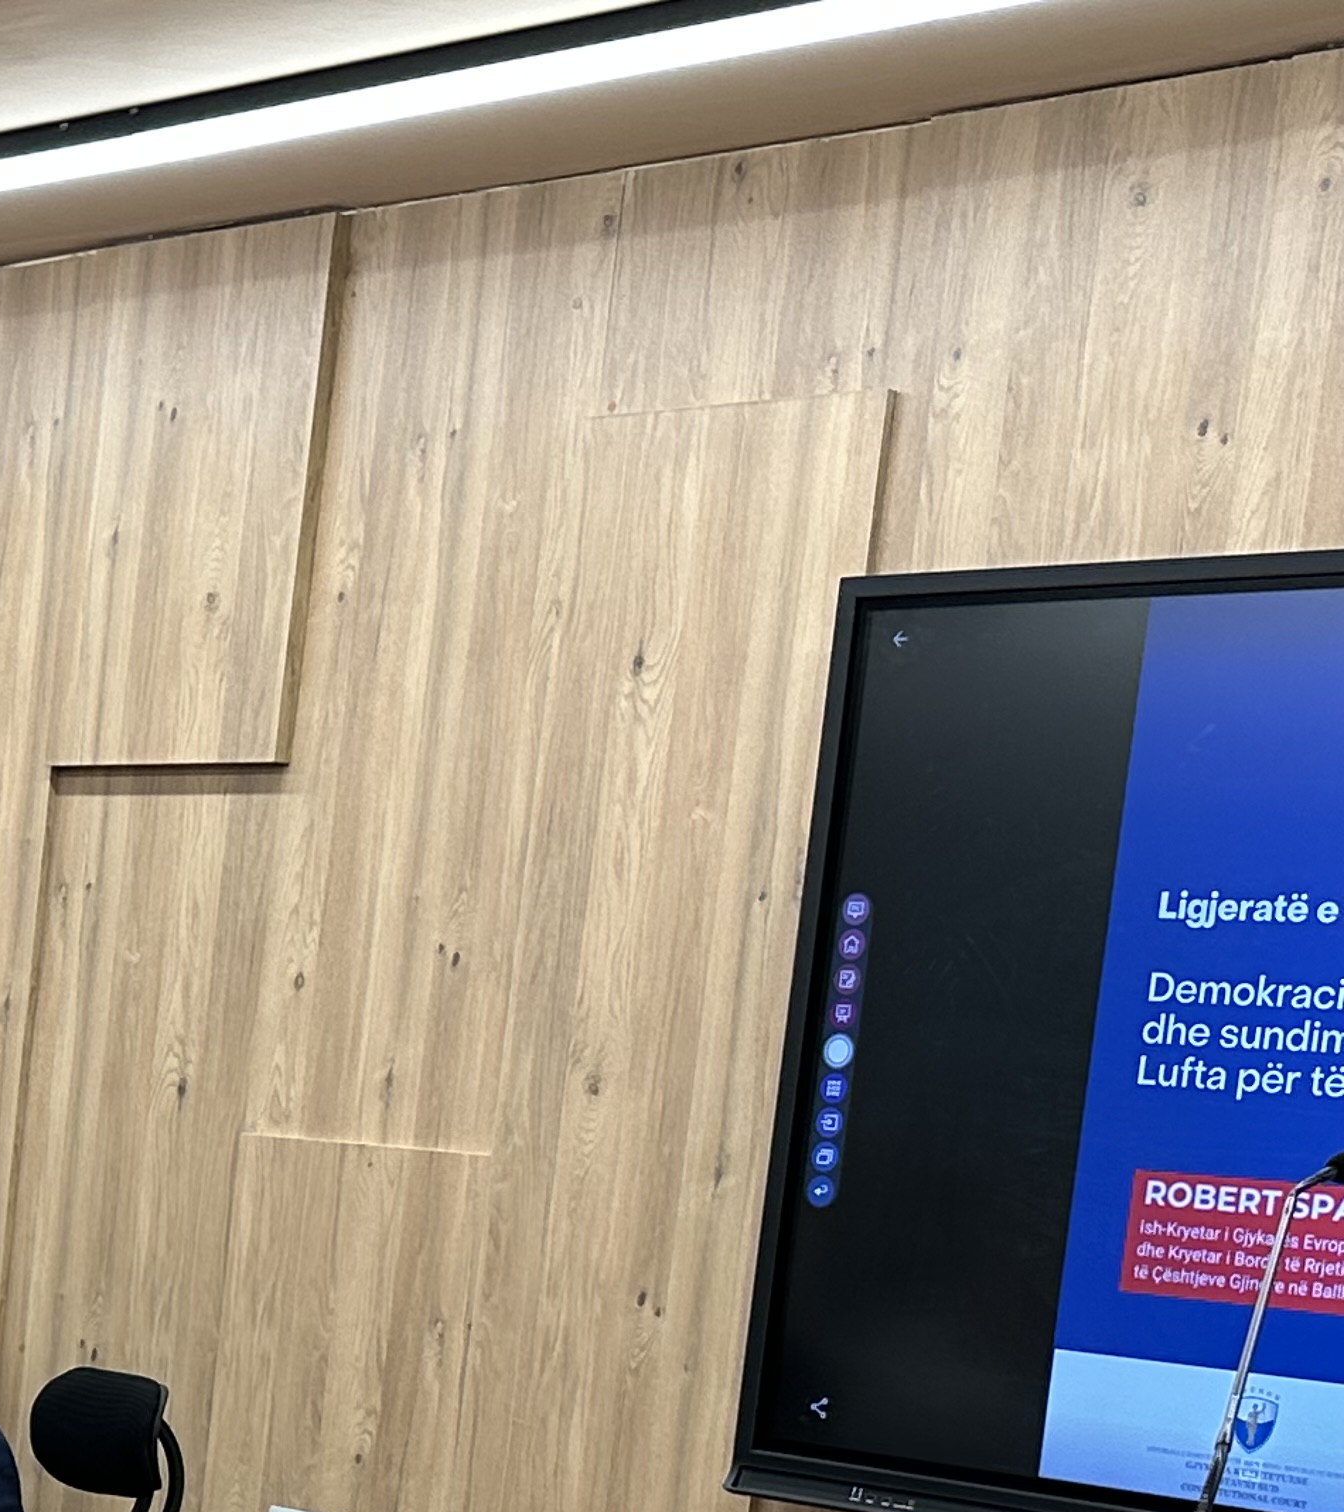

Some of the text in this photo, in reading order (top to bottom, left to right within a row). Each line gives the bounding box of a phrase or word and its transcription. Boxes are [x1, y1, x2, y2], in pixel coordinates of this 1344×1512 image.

[1158, 890, 1339, 928] Ligjeratë e
[1148, 971, 1344, 1010] Demokraci
[1142, 1013, 1344, 1054] dhe sundim
[1137, 1055, 1344, 1101] Lufta për të
[1144, 1179, 1283, 1216] ROBERT
[1223, 1226, 1229, 1241] i
[1233, 1228, 1299, 1249] Gjykas
[1136, 1241, 1165, 1258] dhe
[1168, 1245, 1223, 1264] Kryetar
[1225, 1249, 1231, 1263] i
[1284, 1256, 1301, 1272] të
[1133, 1264, 1149, 1278] të
[1152, 1266, 1226, 1290] Çështjeve
[1229, 1274, 1285, 1294] Gjine
[1288, 1280, 1308, 1296] në
